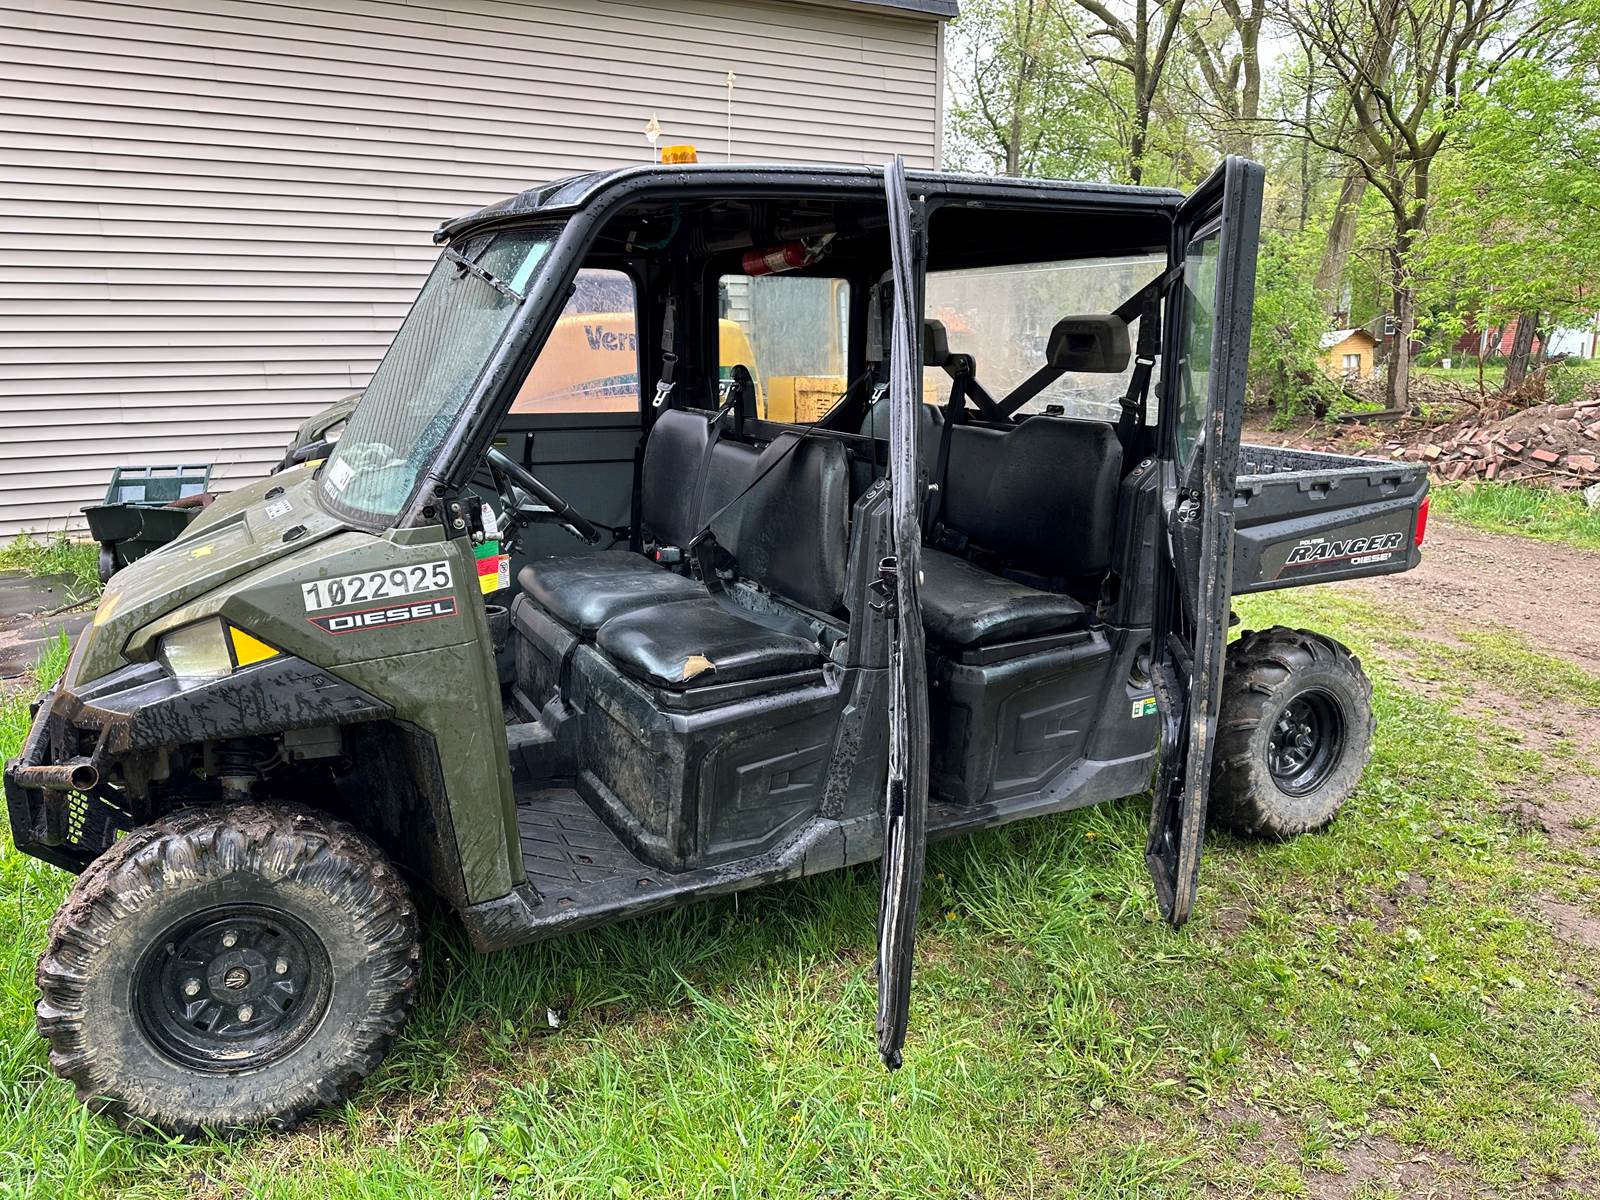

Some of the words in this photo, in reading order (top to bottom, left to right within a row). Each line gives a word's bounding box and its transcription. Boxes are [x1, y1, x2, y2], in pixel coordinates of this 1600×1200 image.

[1286, 532, 1403, 563] RANGER
[305, 563, 450, 609] 1022925
[328, 602, 454, 631] DIESEL
